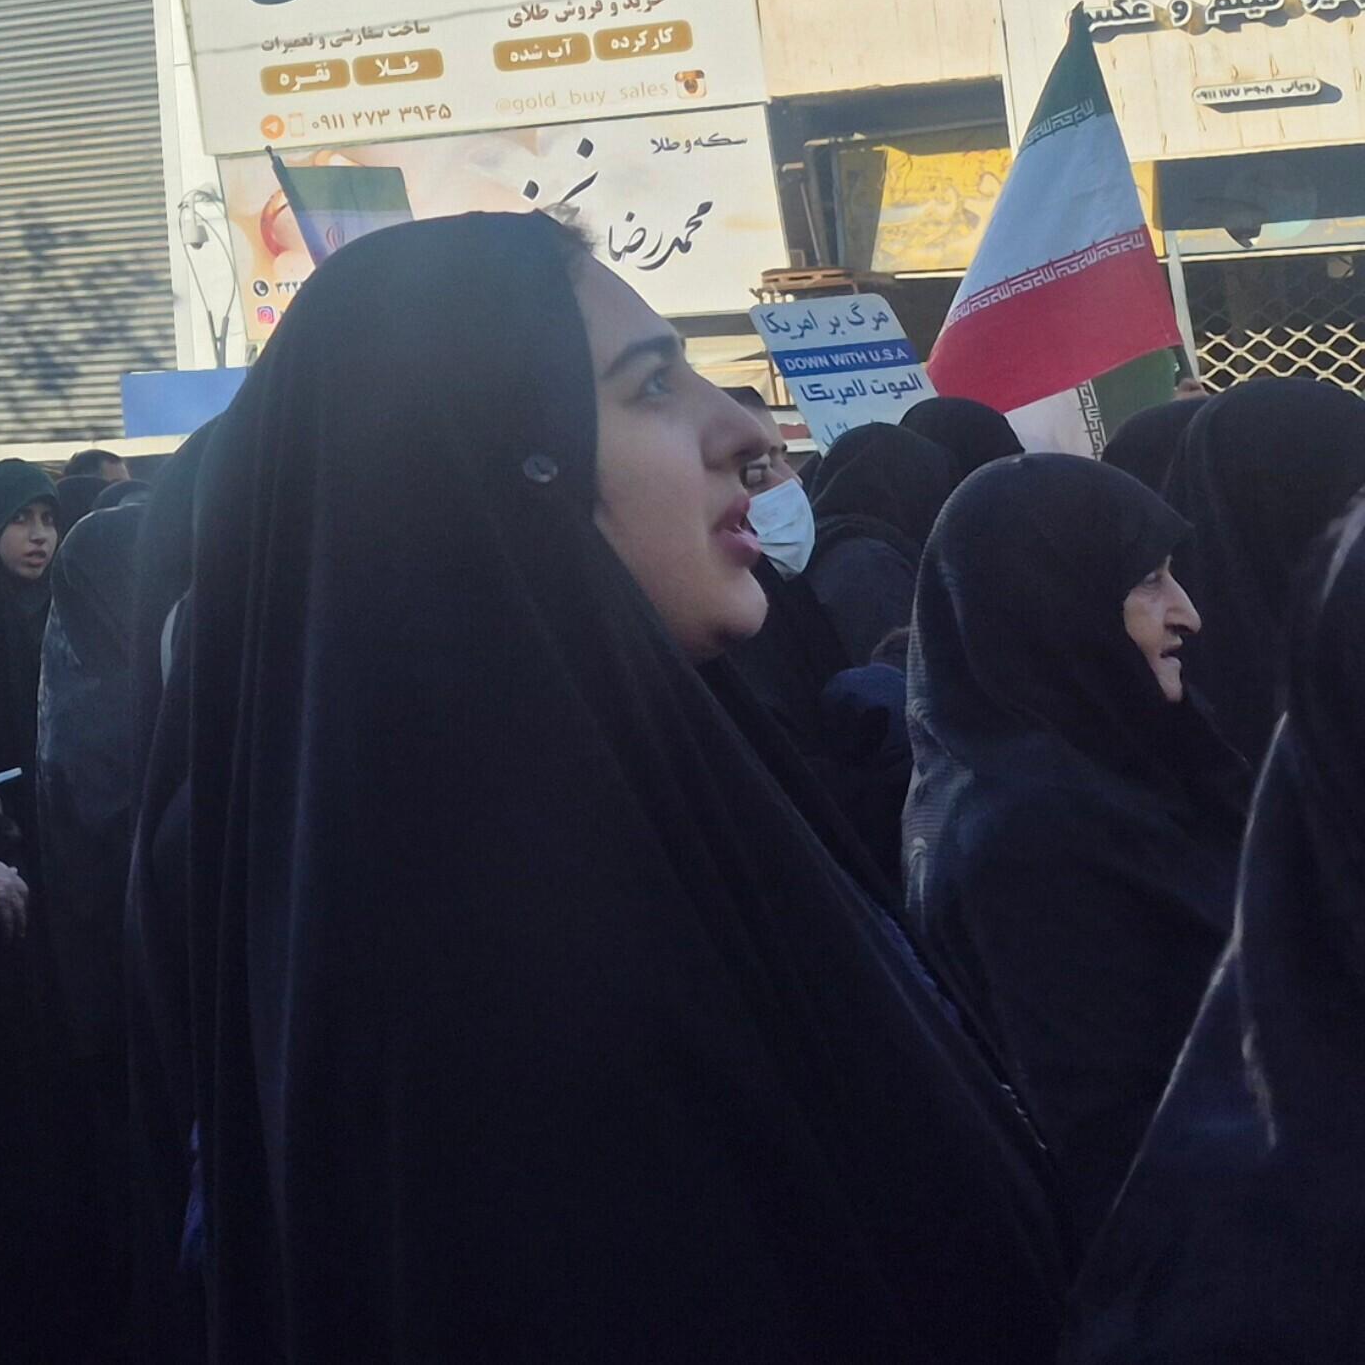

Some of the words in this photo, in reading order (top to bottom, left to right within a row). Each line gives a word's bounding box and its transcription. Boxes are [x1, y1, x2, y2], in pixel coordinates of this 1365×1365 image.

[507, 3, 550, 29] طلای
[609, 0, 618, 18] و
[387, 19, 431, 38] ساخت
[261, 32, 314, 54] تعمیرات
[318, 35, 326, 50] و
[509, 43, 543, 64] شده
[546, 37, 573, 64] آب
[278, 62, 332, 91] نقره
[374, 55, 420, 78] طلا
[311, 112, 346, 131] ۰۹۱۱
[352, 108, 390, 127] ۲۷۳
[398, 102, 453, 124] ۳۹۴۵
[650, 137, 680, 155] طلا
[694, 132, 749, 148] سکه
[760, 309, 819, 340] امریکا
[828, 315, 846, 335] بر
[845, 301, 890, 331] مرگ
[783, 357, 830, 372] DOWN
[829, 351, 869, 367] WITH
[869, 347, 909, 363] U.S.A
[799, 378, 867, 406] لامریکا
[870, 372, 923, 400] الموت
